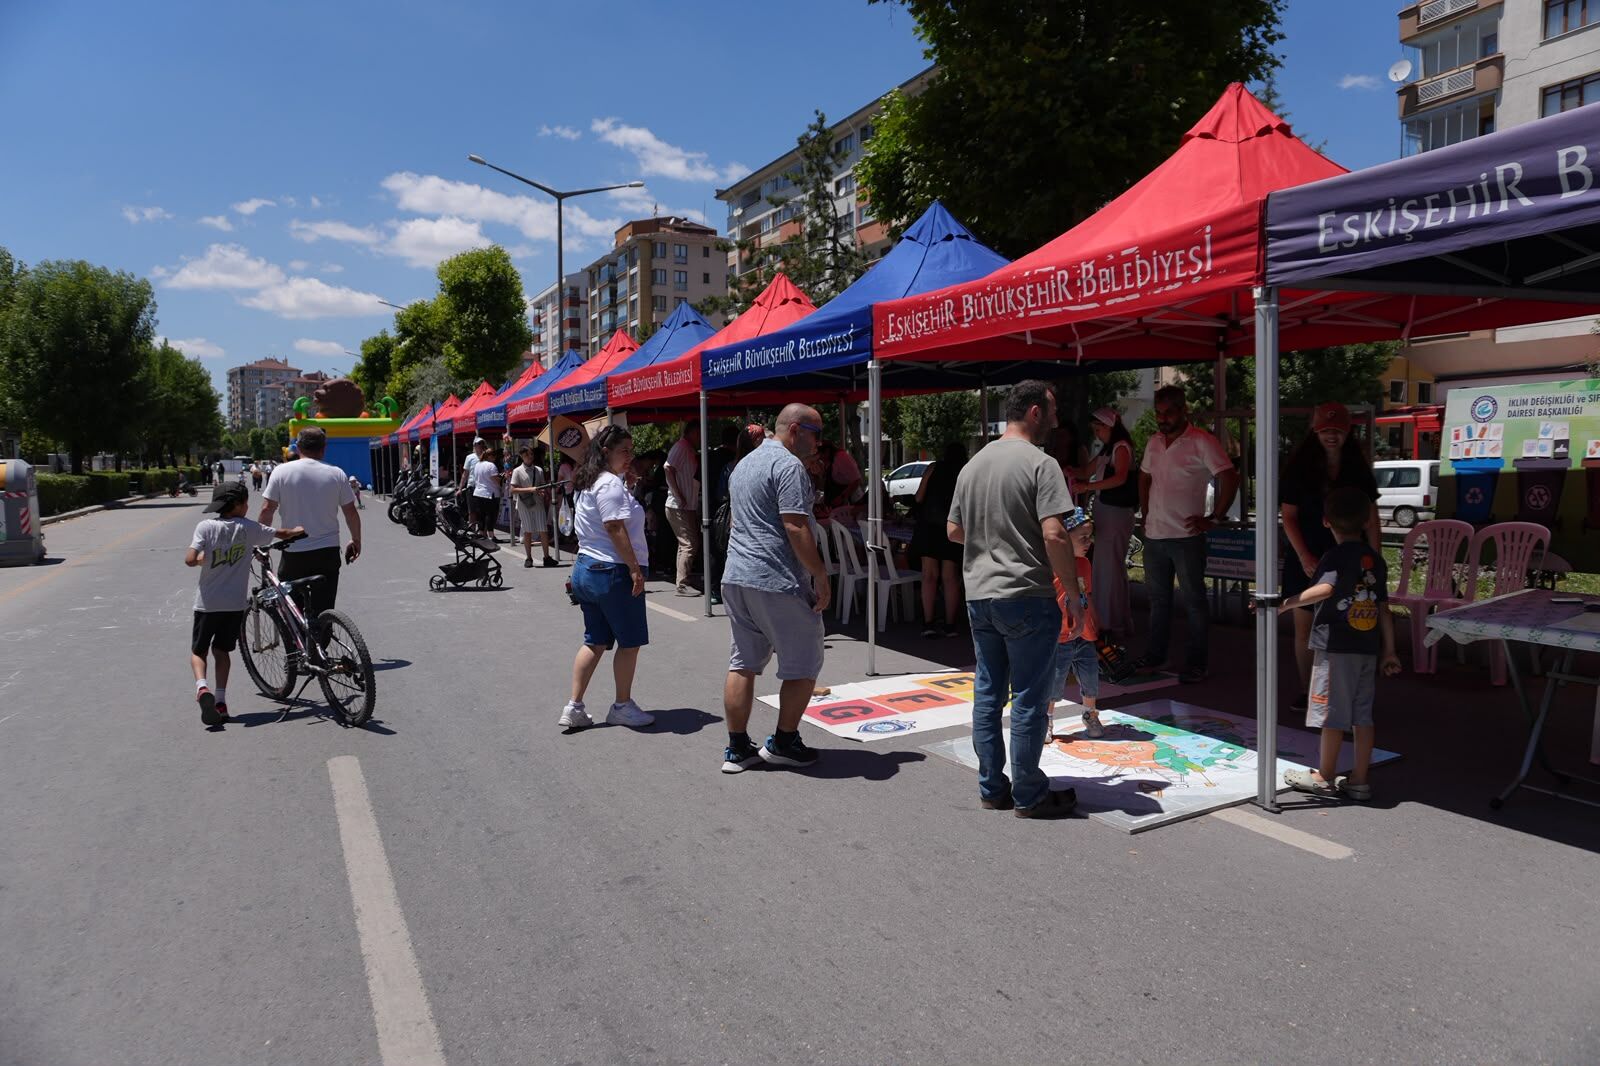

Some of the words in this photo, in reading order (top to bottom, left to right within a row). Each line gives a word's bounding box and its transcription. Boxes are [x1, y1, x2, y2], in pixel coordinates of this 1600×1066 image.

[1317, 161, 1535, 254] ESKİŞEHİR
[1556, 145, 1600, 199] B
[888, 299, 957, 338] ESKİŞEHİR
[962, 269, 1074, 324] BÜYÜKŞEHİR
[1080, 225, 1213, 298] BELEDİYESİ
[820, 705, 874, 720] G
